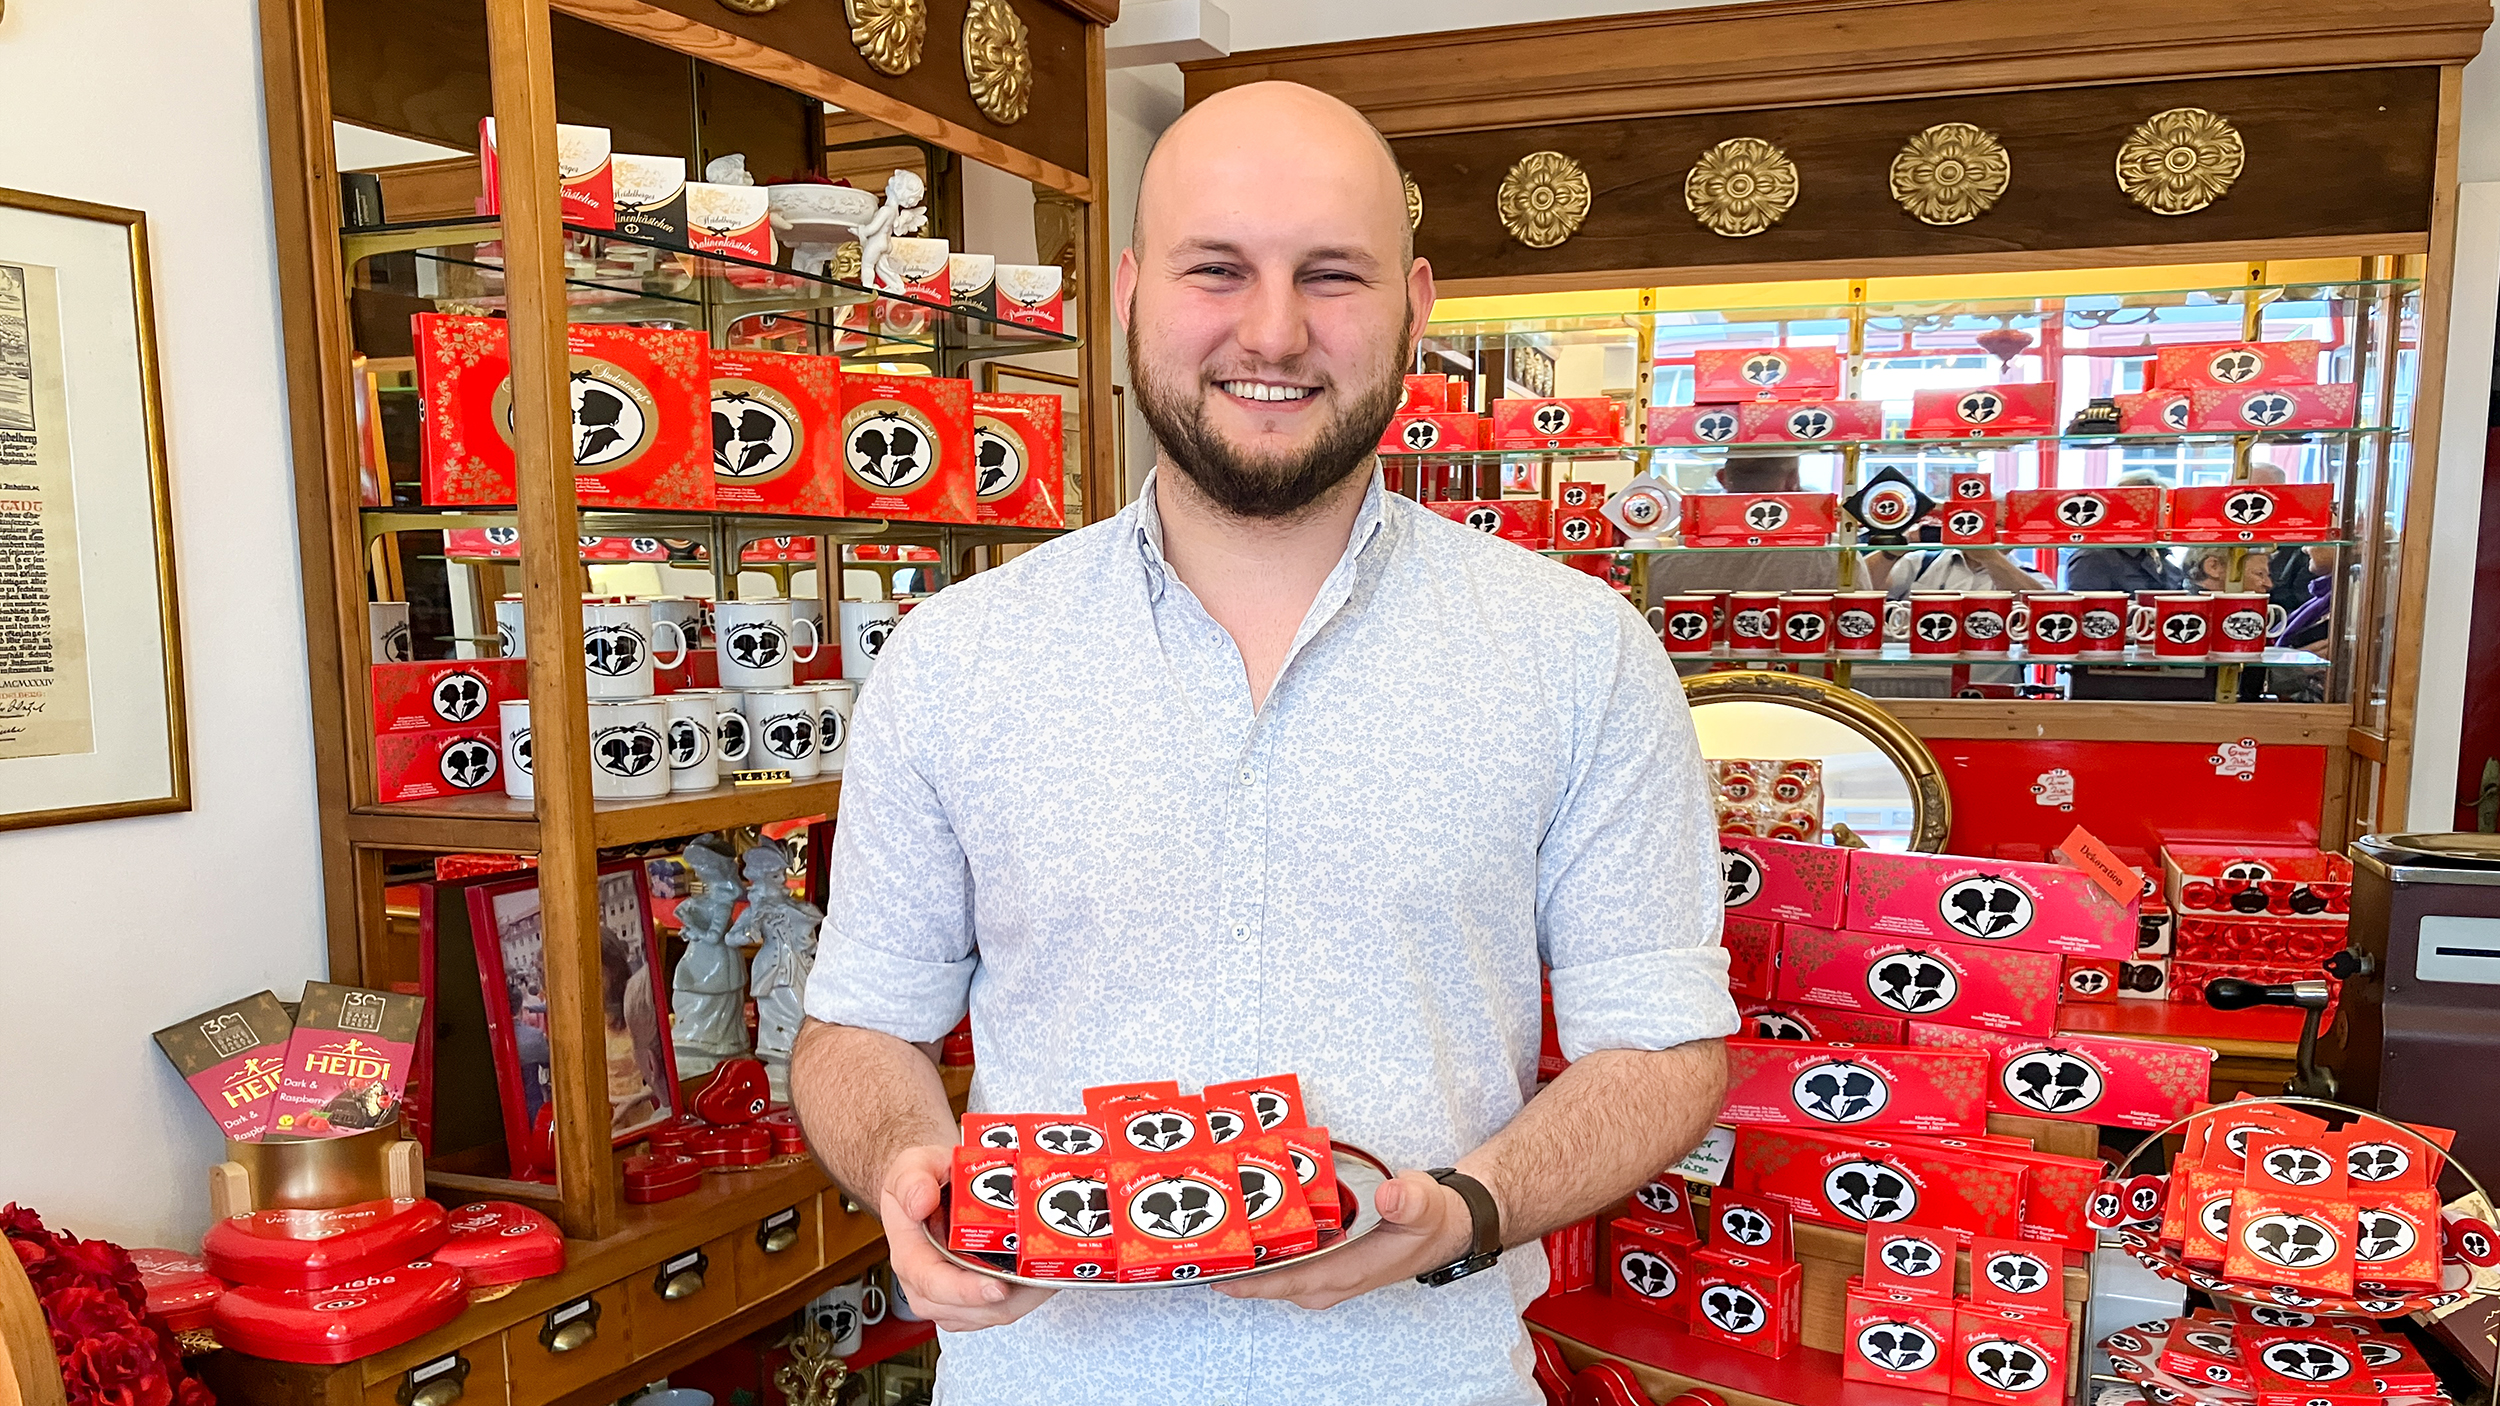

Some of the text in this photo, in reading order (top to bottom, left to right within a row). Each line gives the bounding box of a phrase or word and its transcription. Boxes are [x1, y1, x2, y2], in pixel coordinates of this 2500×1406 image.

[0, 500, 43, 512] TADT
[2080, 845, 2123, 886] Dekoration
[305, 1053, 392, 1081] HEIDI
[284, 1078, 318, 1089] Dark &
[280, 1092, 329, 1107] Raspberry
[224, 1115, 248, 1129] Dark
